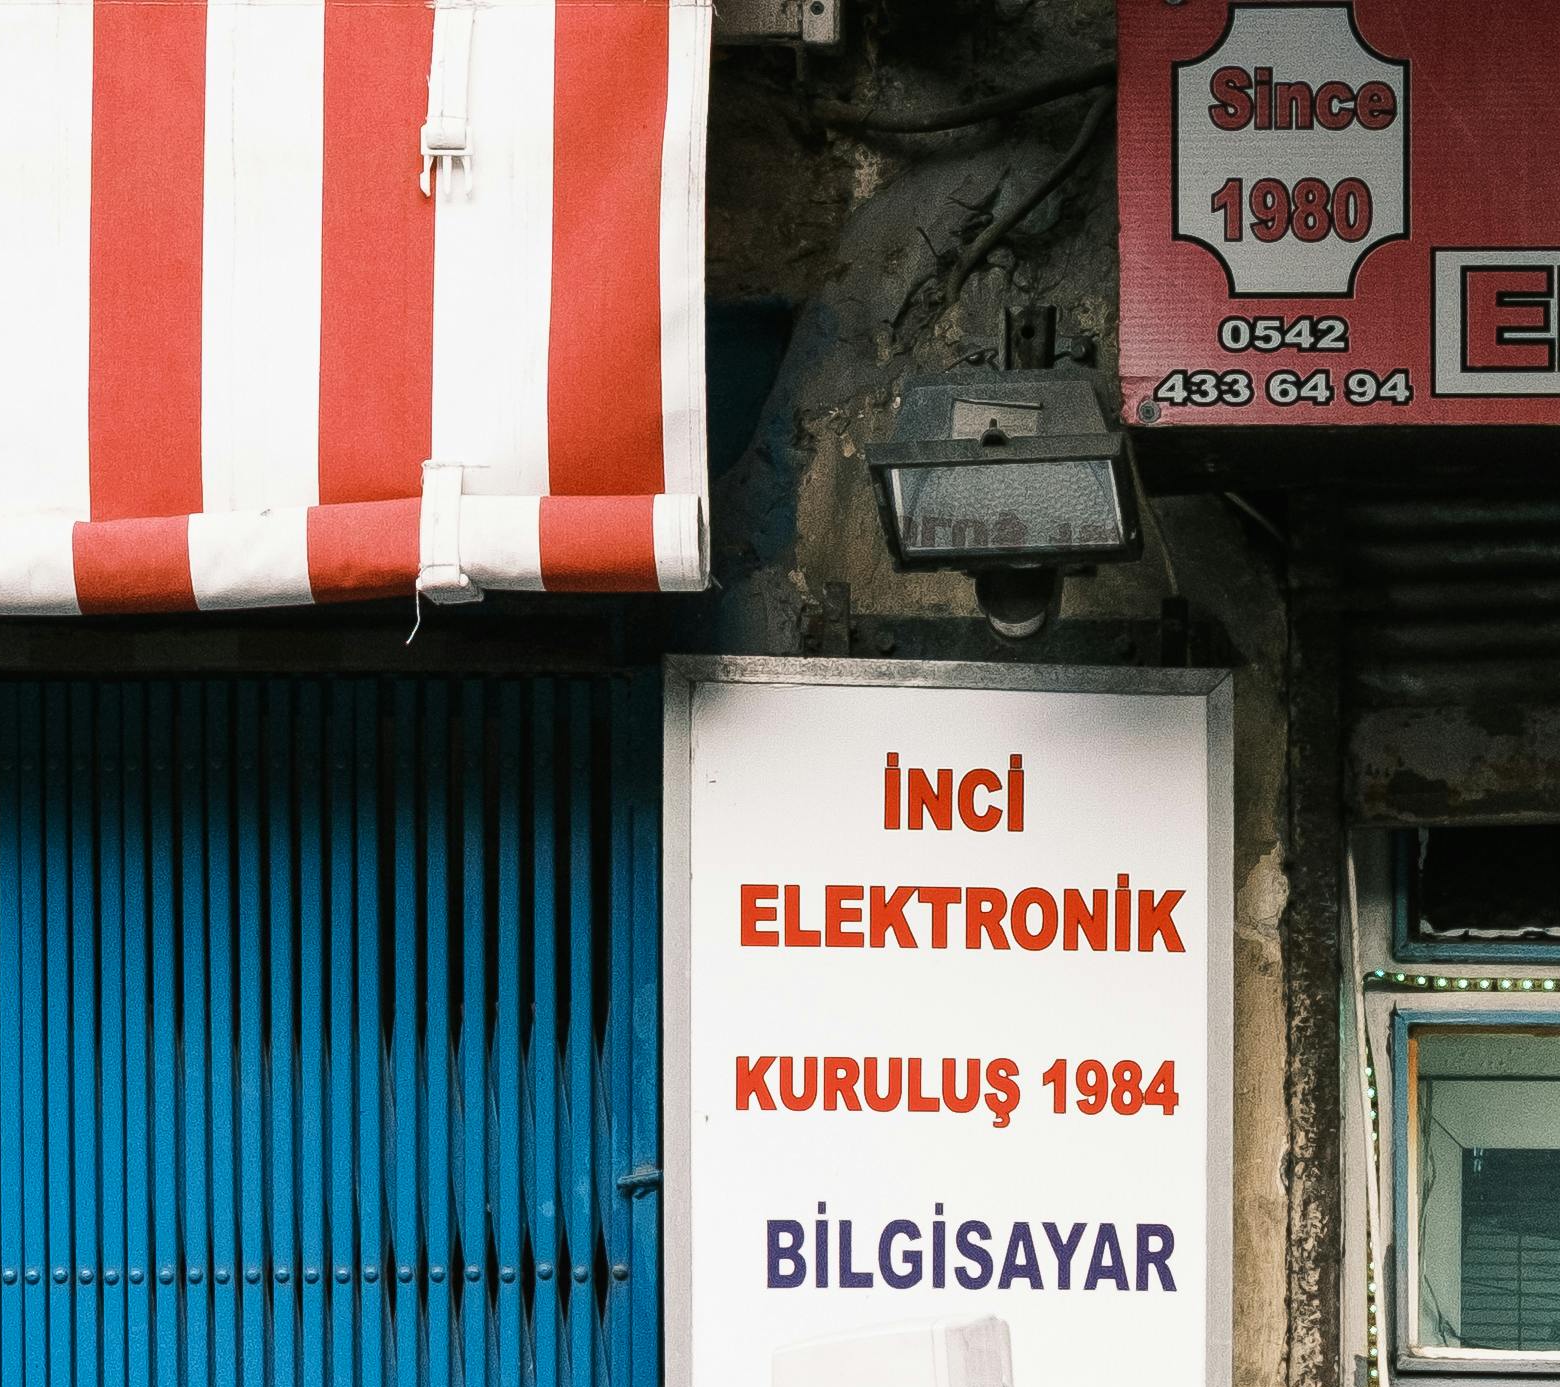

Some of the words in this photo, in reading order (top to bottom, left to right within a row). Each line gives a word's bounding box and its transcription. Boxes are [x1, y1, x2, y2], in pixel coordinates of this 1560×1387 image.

[1208, 66, 1397, 132] Since
[1208, 177, 1374, 247] 1980
[1218, 314, 1350, 354] 0542
[1153, 367, 1258, 409] 433
[1265, 367, 1330, 409] 64
[1335, 367, 1412, 409] 94
[883, 752, 1027, 833] İNCİ
[738, 872, 1187, 955] ELEKTRONİK
[732, 1055, 1023, 1129] KURULUŞ
[1040, 1057, 1180, 1118] 1984
[764, 1200, 1177, 1294] BİLGİSAYAR
